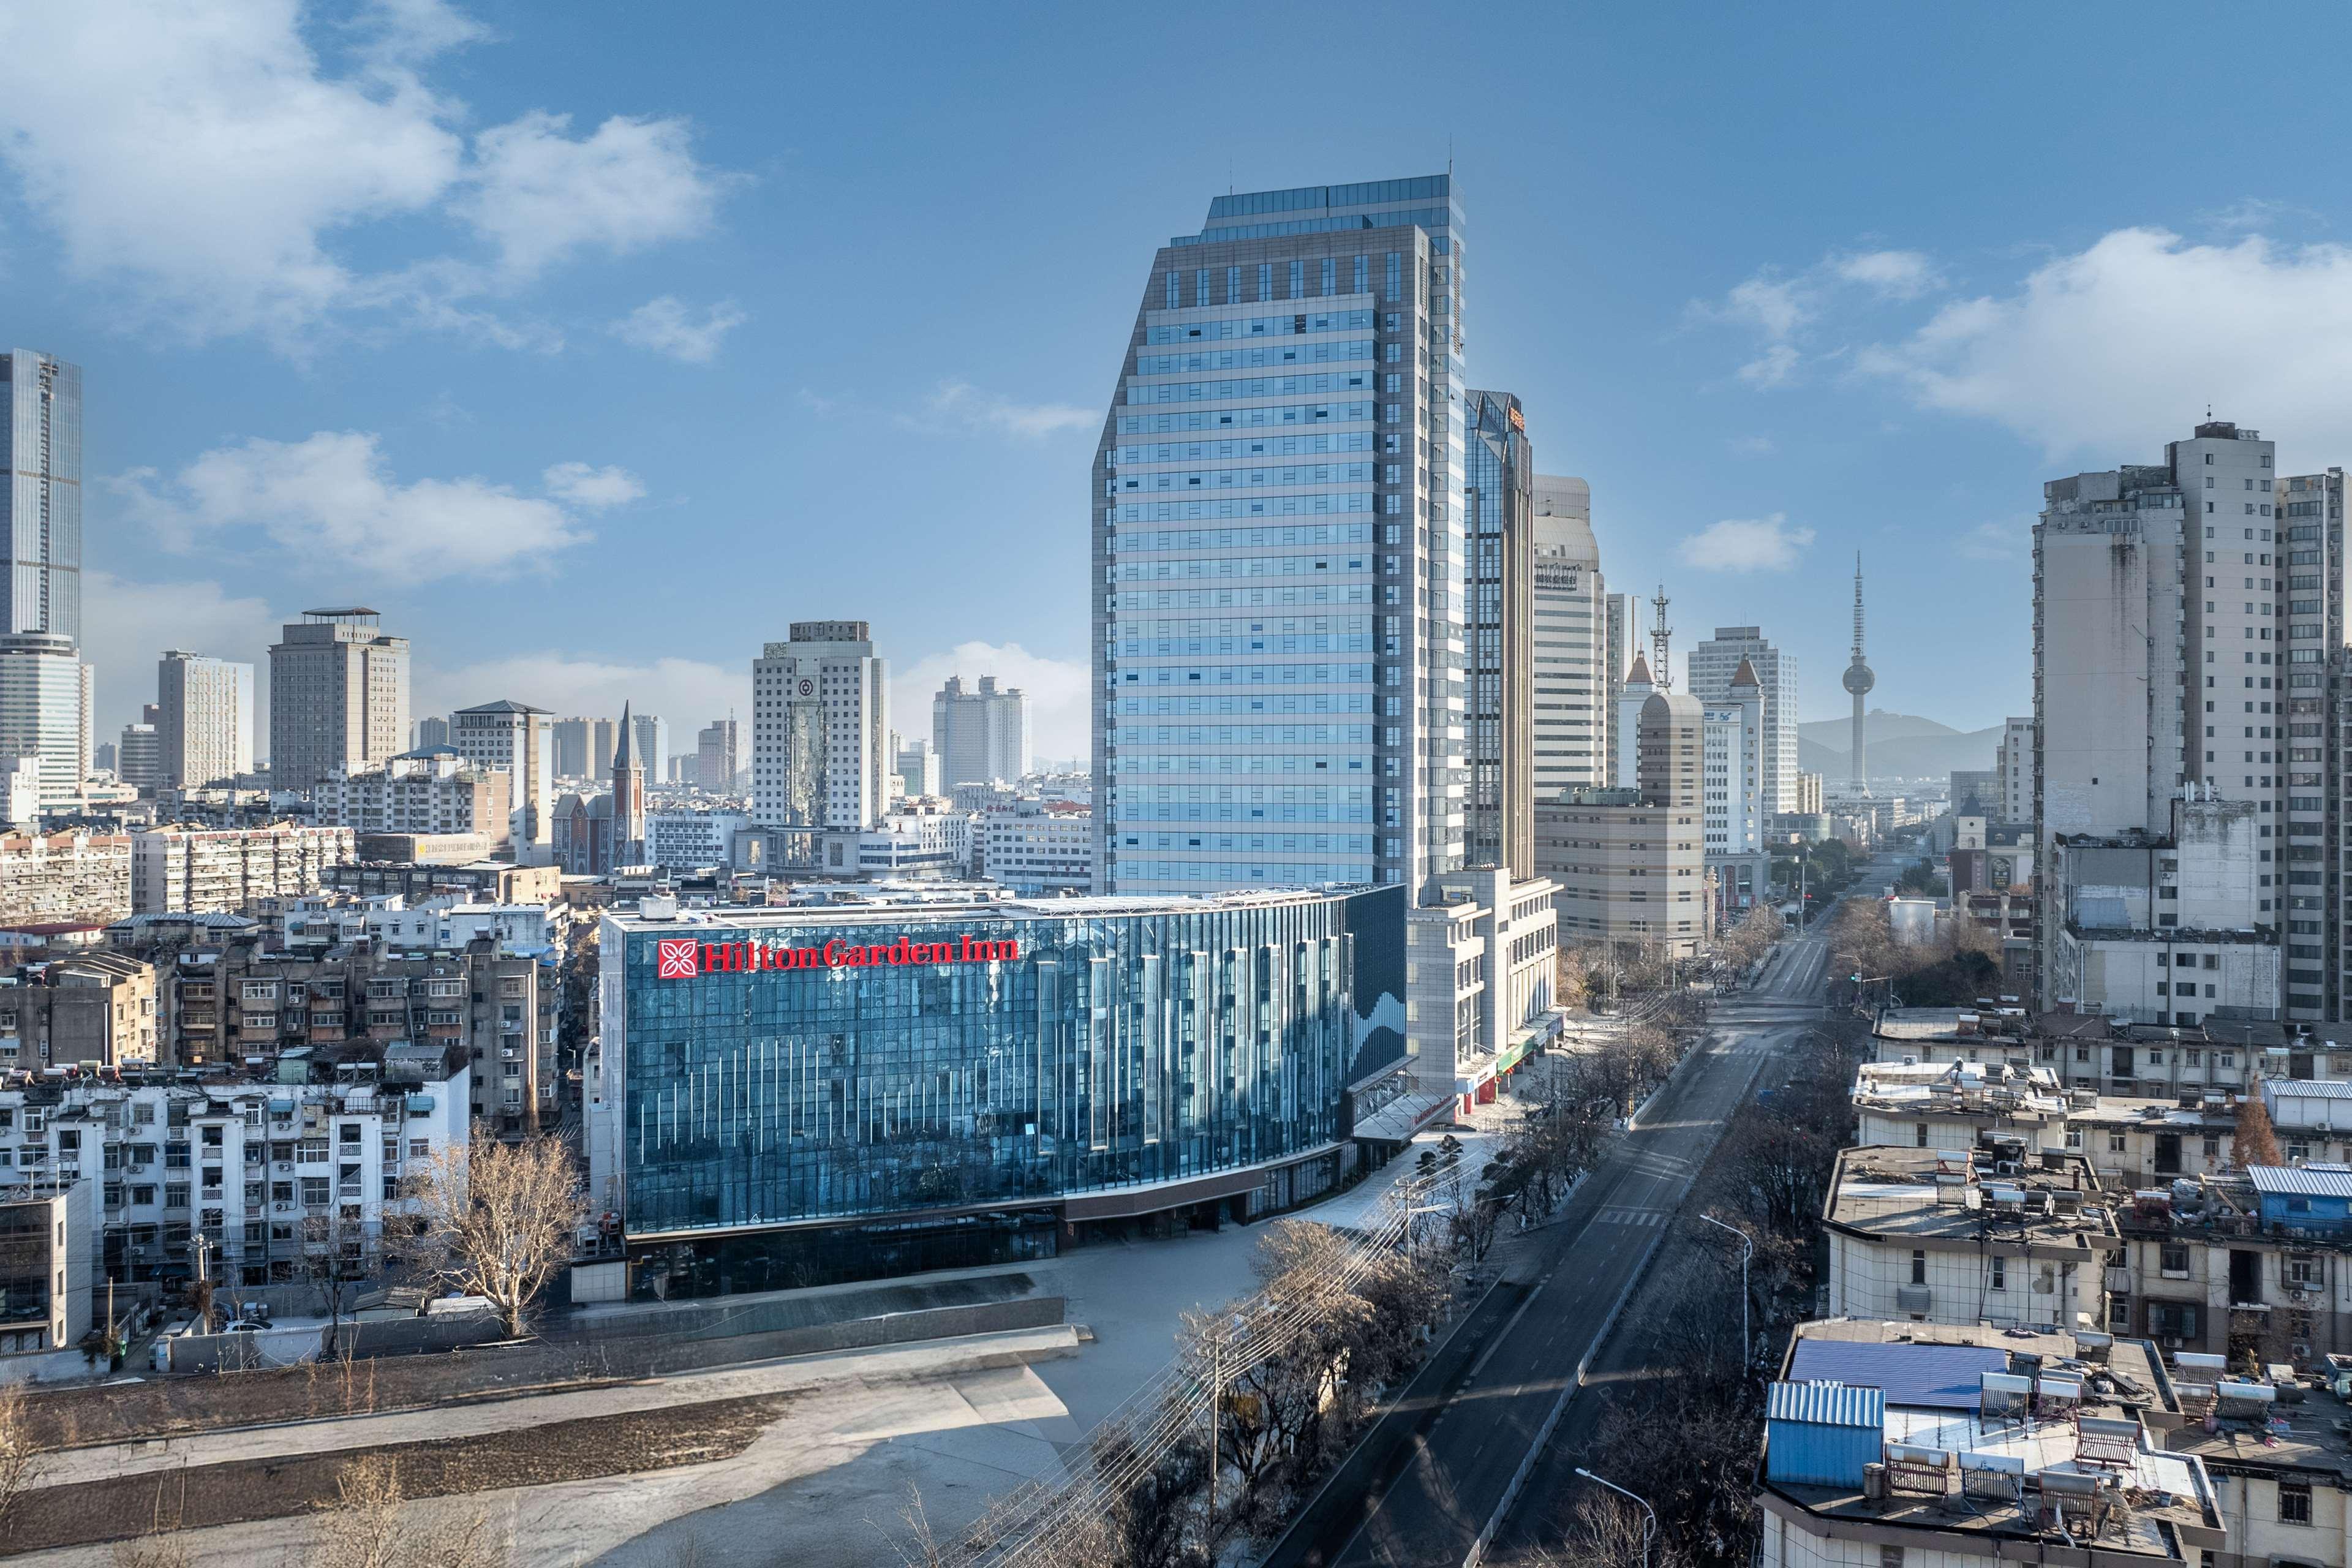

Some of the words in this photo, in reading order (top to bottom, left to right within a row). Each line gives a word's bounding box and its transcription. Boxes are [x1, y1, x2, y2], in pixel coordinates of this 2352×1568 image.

[704, 941, 819, 973] Hilton
[823, 936, 953, 968] Garden
[959, 934, 1020, 963] Inn
